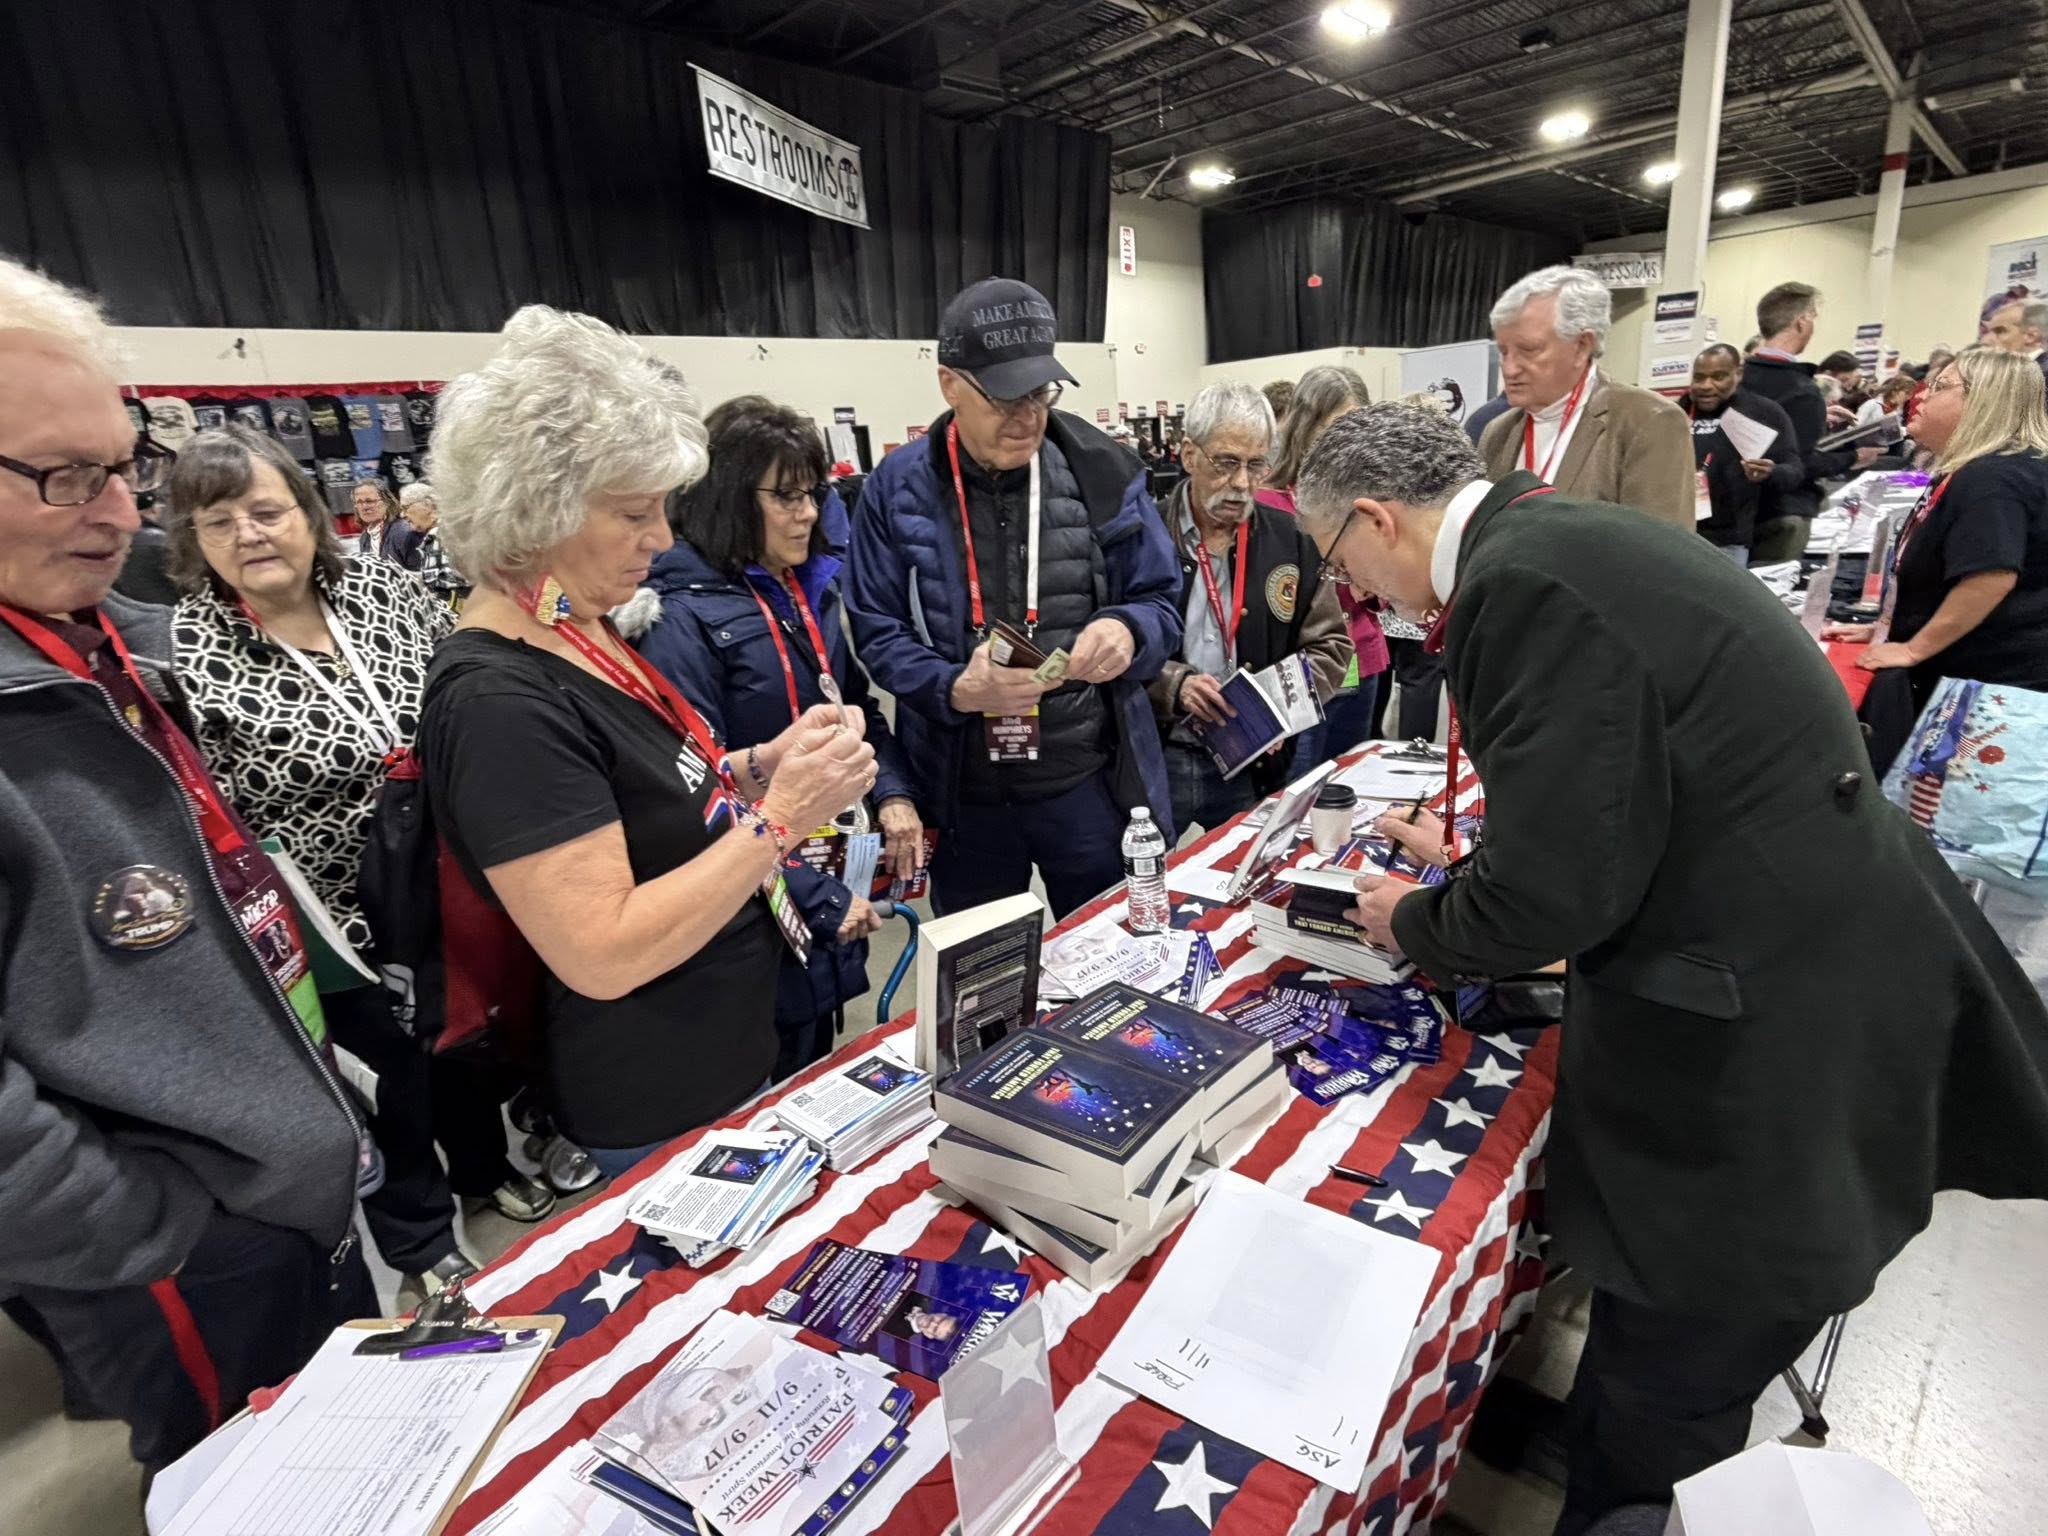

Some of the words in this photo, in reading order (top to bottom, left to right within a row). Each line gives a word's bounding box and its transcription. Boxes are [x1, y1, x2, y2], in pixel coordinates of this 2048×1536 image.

[704, 96, 838, 200] RESTROOMS
[1123, 228, 1131, 261] EXIT
[1578, 261, 1657, 281] CESSIONS
[972, 303, 1014, 328] MAKE
[983, 326, 1029, 350] GREAT
[124, 920, 175, 938] TRUMP
[1016, 1058, 1046, 1077] FORGED
[989, 1075, 1023, 1100] AMERICA
[754, 1381, 801, 1418] 9/11
[794, 1395, 831, 1430] Renewing
[775, 1392, 856, 1471] PATRIOT
[782, 1430, 798, 1442] the
[434, 1445, 461, 1481] SIGN-IN
[701, 1428, 749, 1471] 9/17
[742, 1442, 784, 1478] American
[1296, 1444, 1341, 1469] ASG
[414, 1481, 438, 1512] SHEET
[715, 1469, 779, 1524] WEEK
[721, 1477, 747, 1501] Spirit
